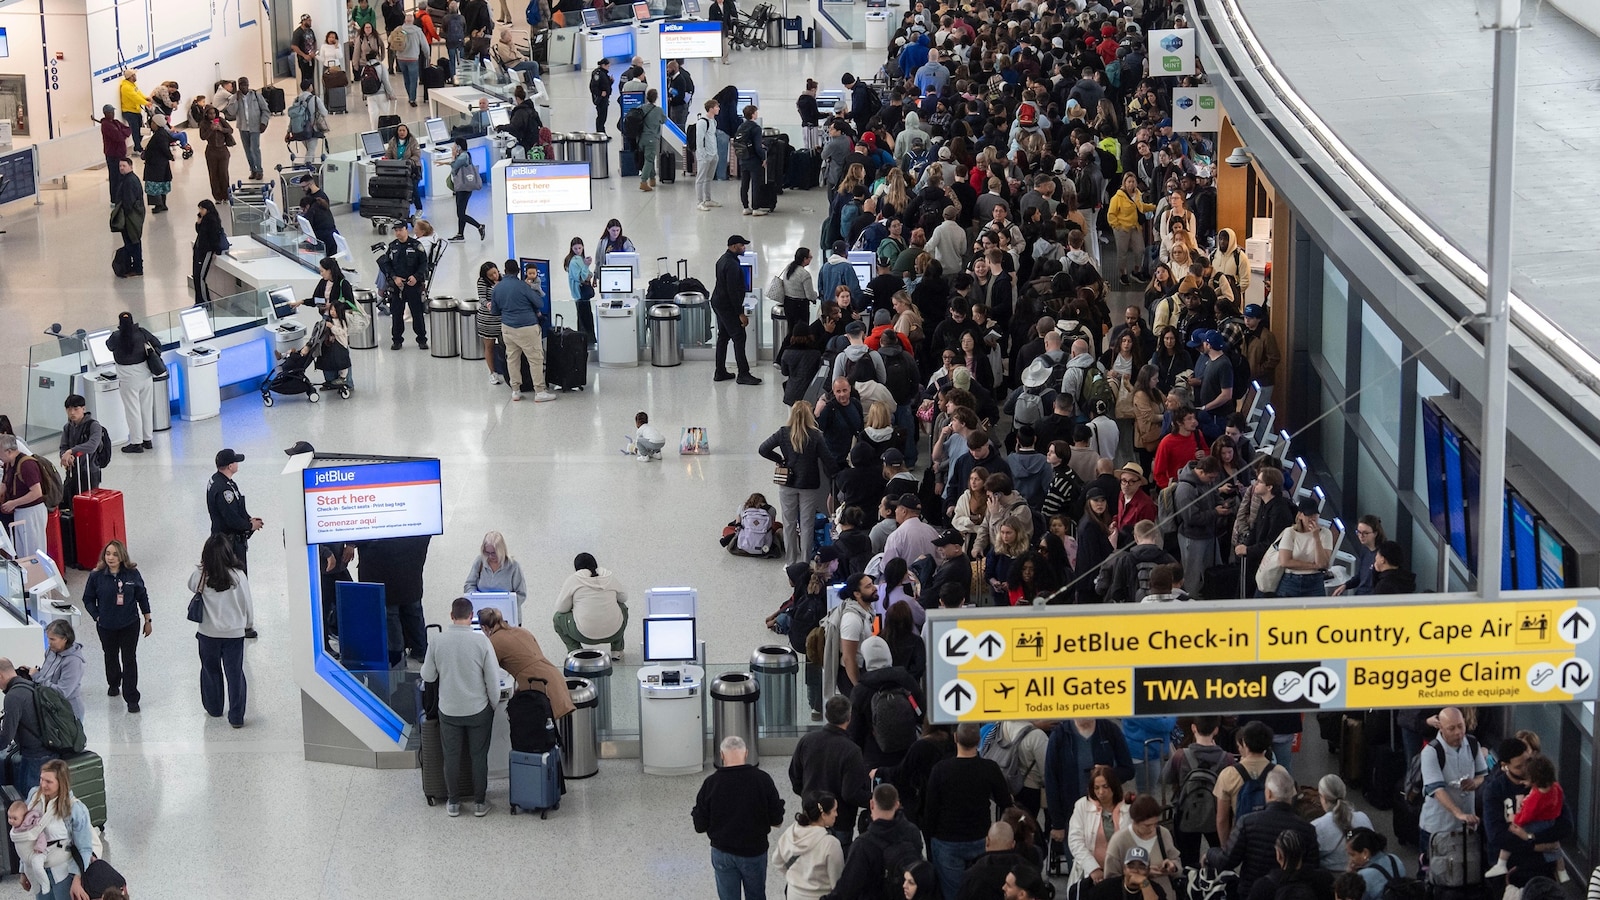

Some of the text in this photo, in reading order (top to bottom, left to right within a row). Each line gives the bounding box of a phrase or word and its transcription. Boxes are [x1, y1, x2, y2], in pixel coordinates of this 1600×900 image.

[512, 167, 537, 176] jetBlue
[315, 471, 355, 485] jetBlue
[317, 494, 376, 506] Start here
[318, 519, 358, 528] Comenzar
[1267, 617, 1513, 647] Sun Country, Cape Air
[1053, 627, 1249, 654] JetBlue Check-in
[1353, 661, 1521, 691] Baggage Claim
[1025, 675, 1127, 698] All Gates
[1142, 674, 1267, 702] TWA Hotel
[1418, 685, 1520, 699] Reclamo de equipaje
[1025, 701, 1110, 713] Todas las puertas
